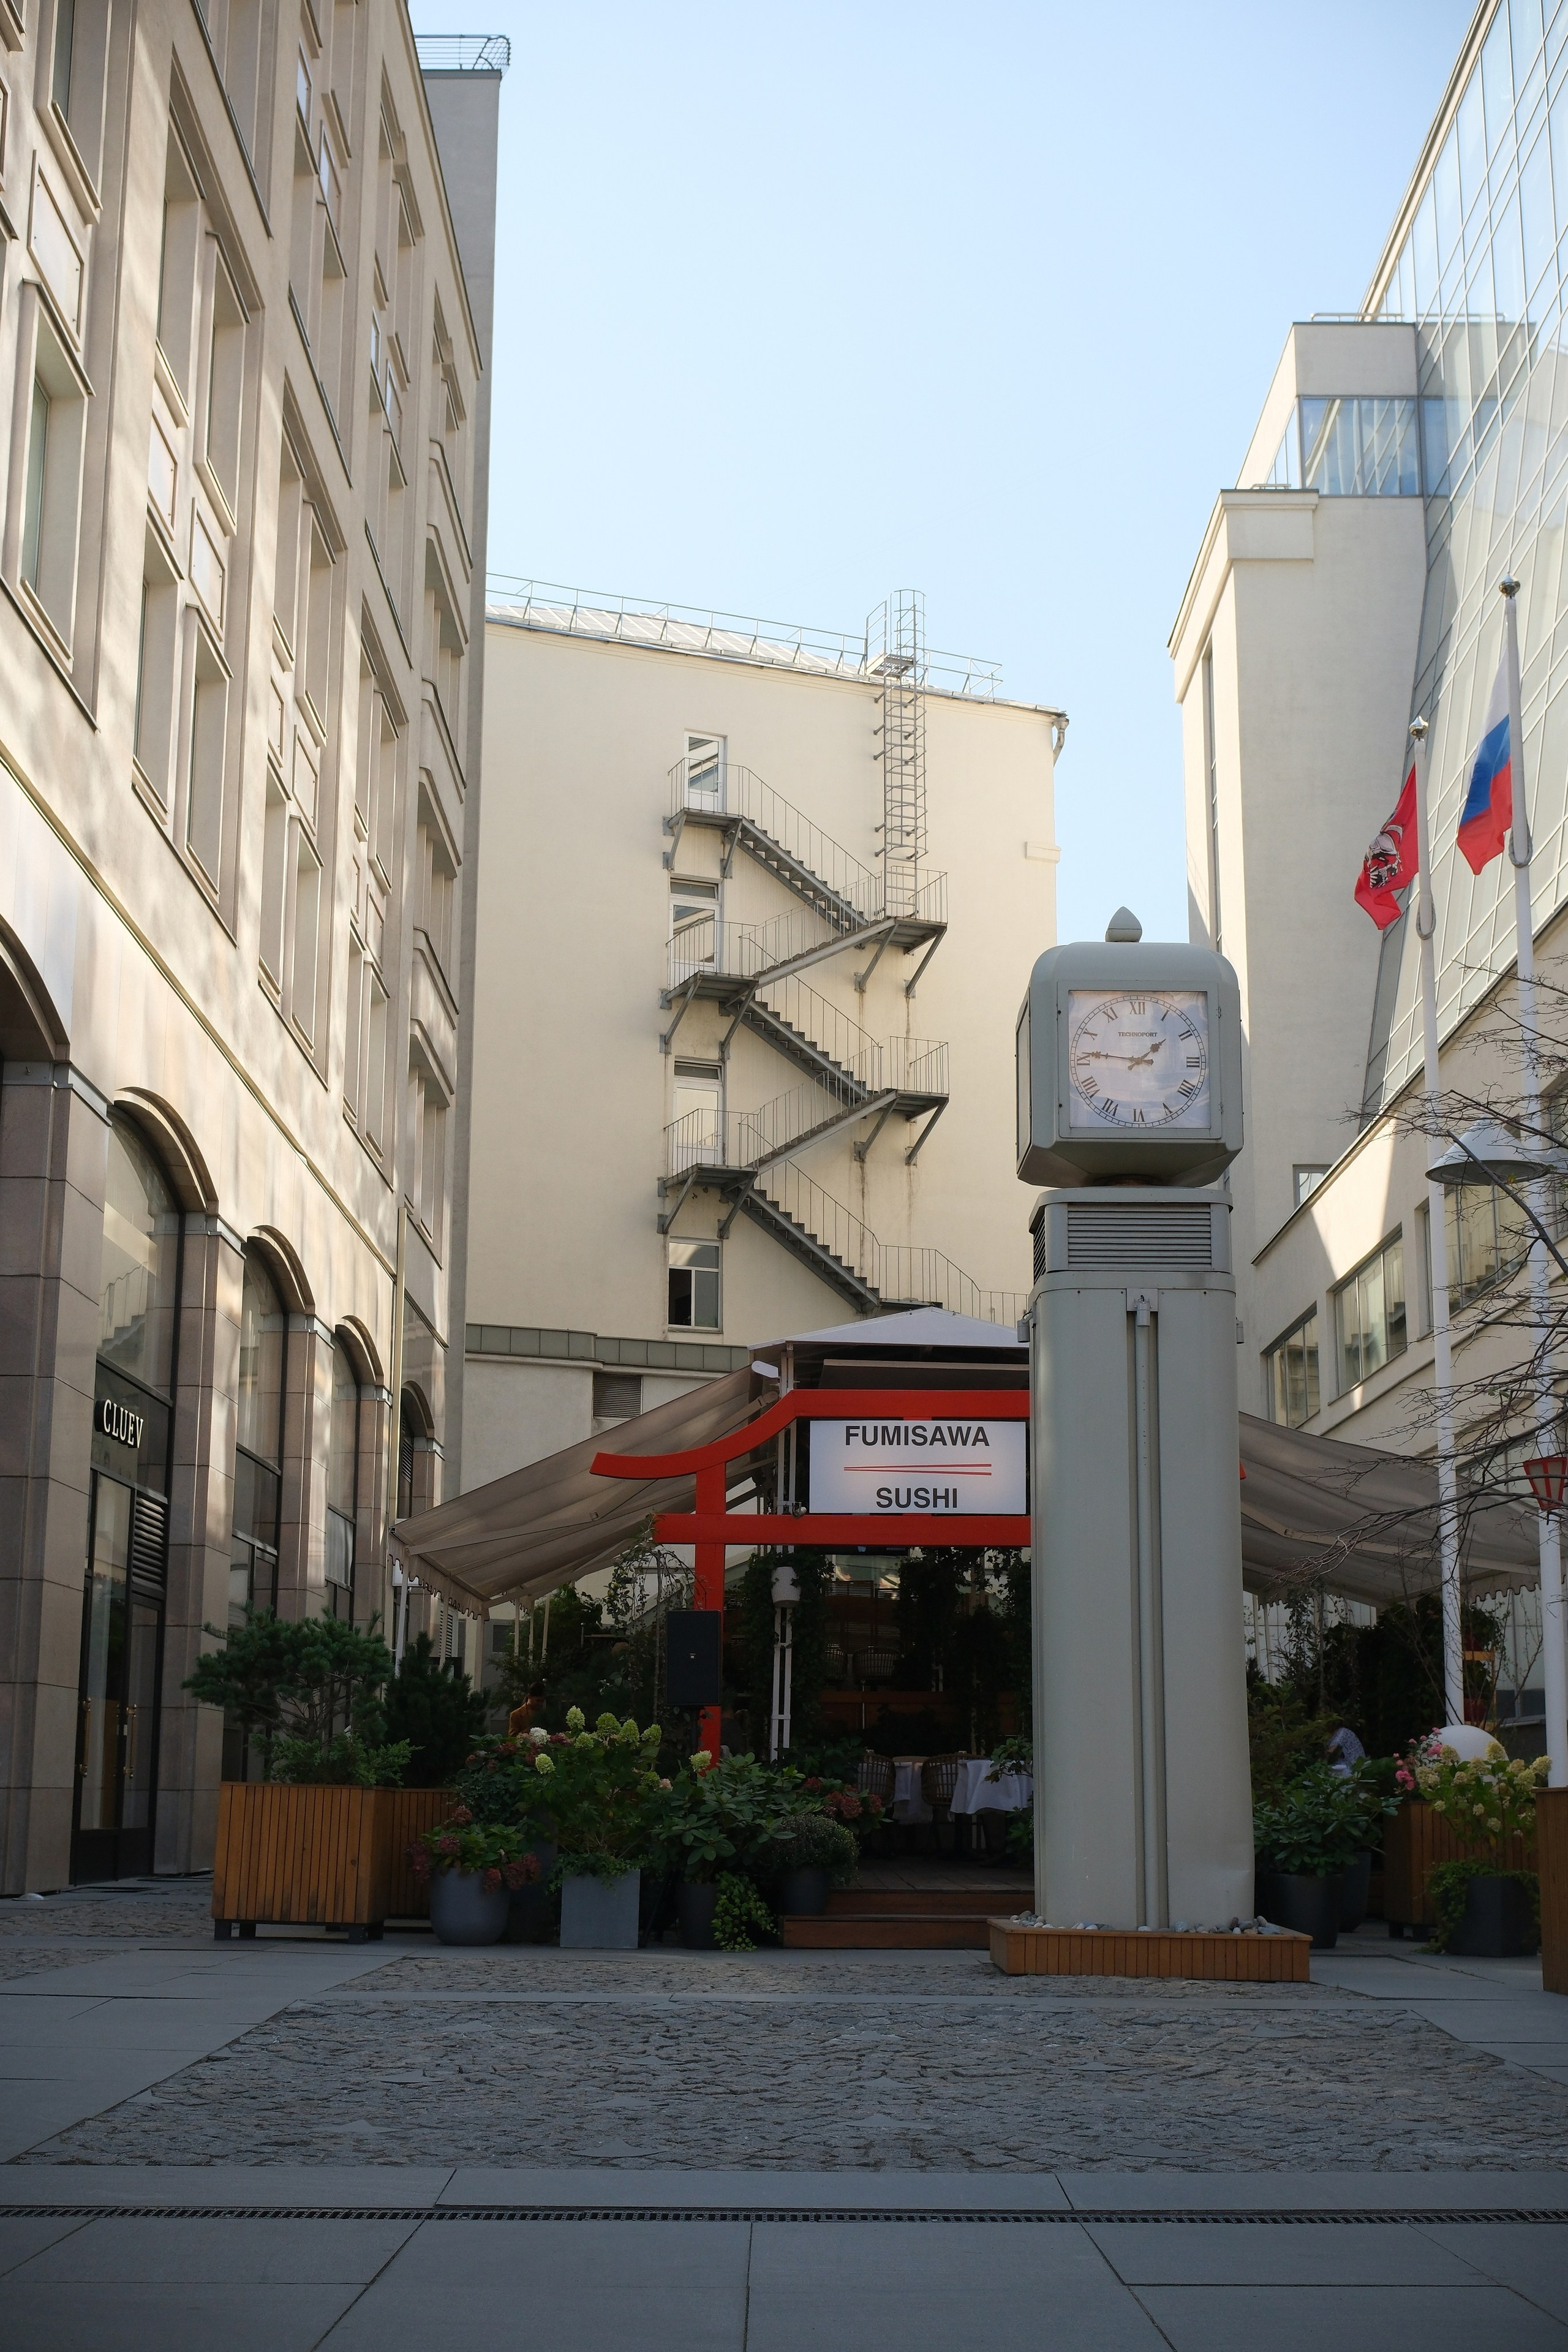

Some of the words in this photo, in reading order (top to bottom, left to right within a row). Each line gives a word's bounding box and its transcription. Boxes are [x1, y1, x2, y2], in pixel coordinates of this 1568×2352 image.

[1102, 1006, 1118, 1023] XI
[1129, 1001, 1145, 1014] XII
[1083, 1028, 1098, 1041] X
[1178, 1029, 1193, 1041] II
[1186, 1056, 1200, 1068] III
[1080, 1076, 1100, 1099] VIII
[1101, 1098, 1118, 1117] VII
[1131, 1108, 1145, 1122] VI
[1163, 1102, 1173, 1116] V
[104, 1399, 144, 1449] CLUEV
[845, 1425, 990, 1447] FUMISAWA
[875, 1487, 958, 1509] SUSHI
